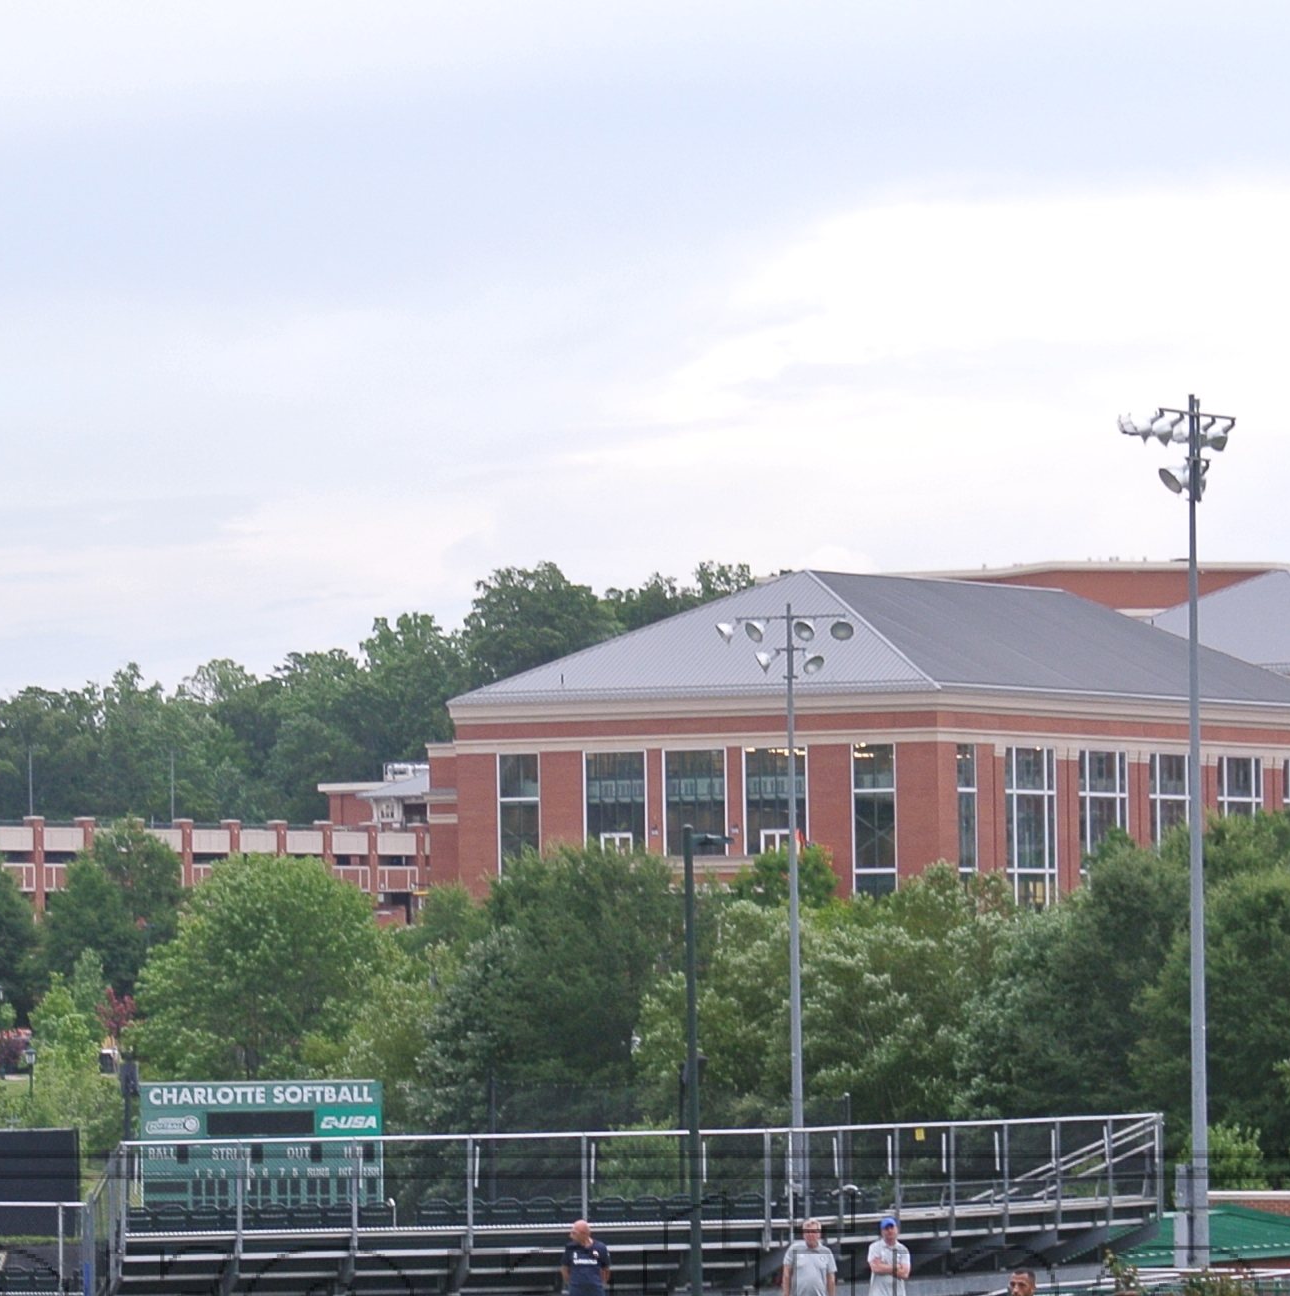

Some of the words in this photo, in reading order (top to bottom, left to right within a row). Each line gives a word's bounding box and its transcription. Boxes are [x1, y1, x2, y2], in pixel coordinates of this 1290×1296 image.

[148, 1086, 266, 1106] CHARLOTTE
[273, 1085, 374, 1105] SOFTBALL
[148, 1147, 177, 1161] BALL
[287, 1146, 310, 1159] OUT
